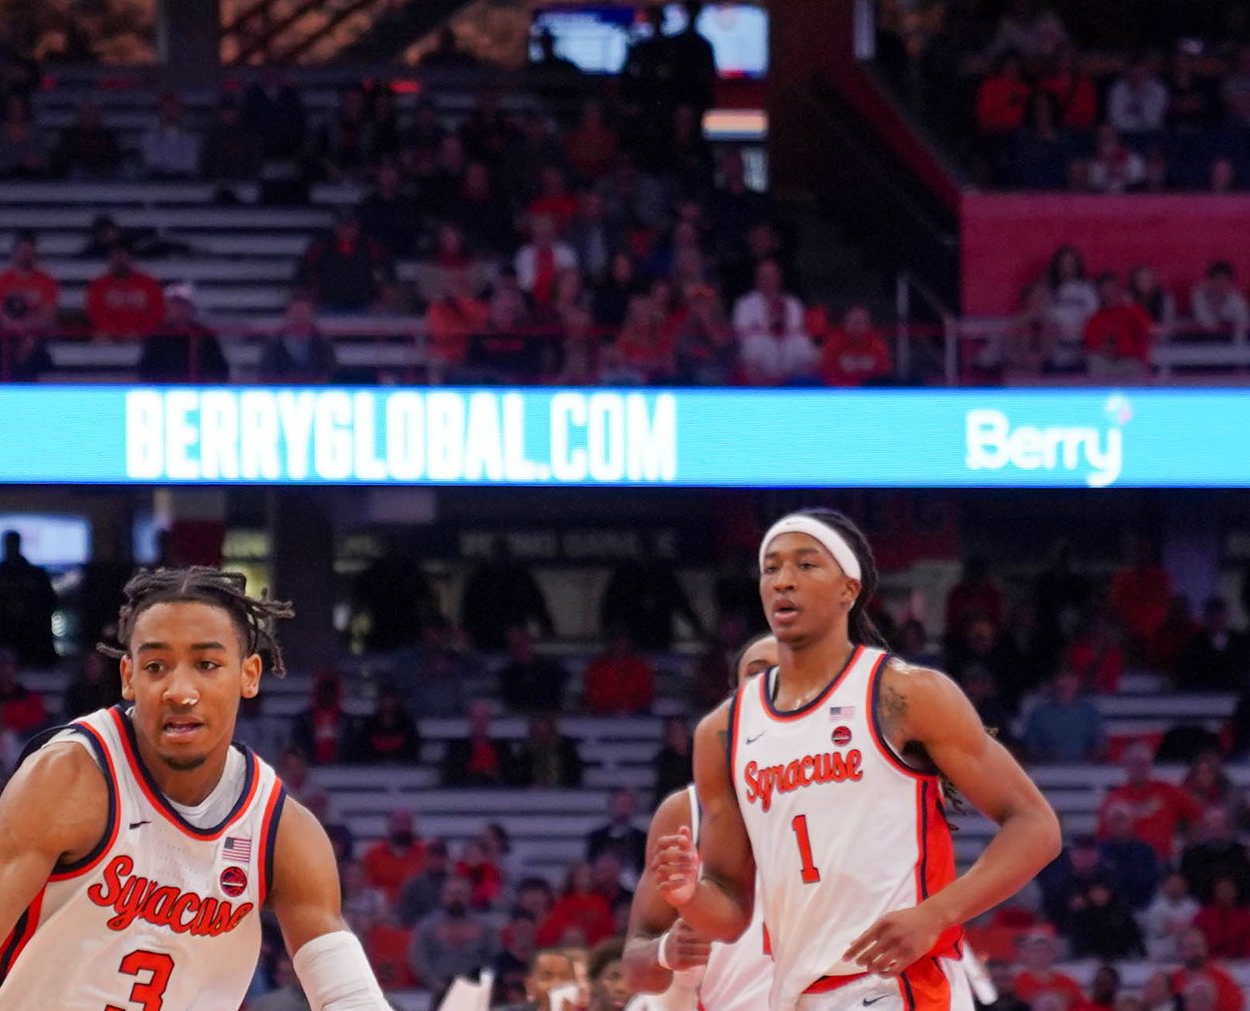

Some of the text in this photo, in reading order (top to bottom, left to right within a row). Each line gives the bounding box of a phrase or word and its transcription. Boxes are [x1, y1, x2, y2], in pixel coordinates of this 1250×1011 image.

[125, 391, 677, 481] BERRYGLOBAL.COM
[965, 408, 1122, 488] Berry
[745, 749, 864, 813] Syracuse
[792, 814, 821, 884] 1
